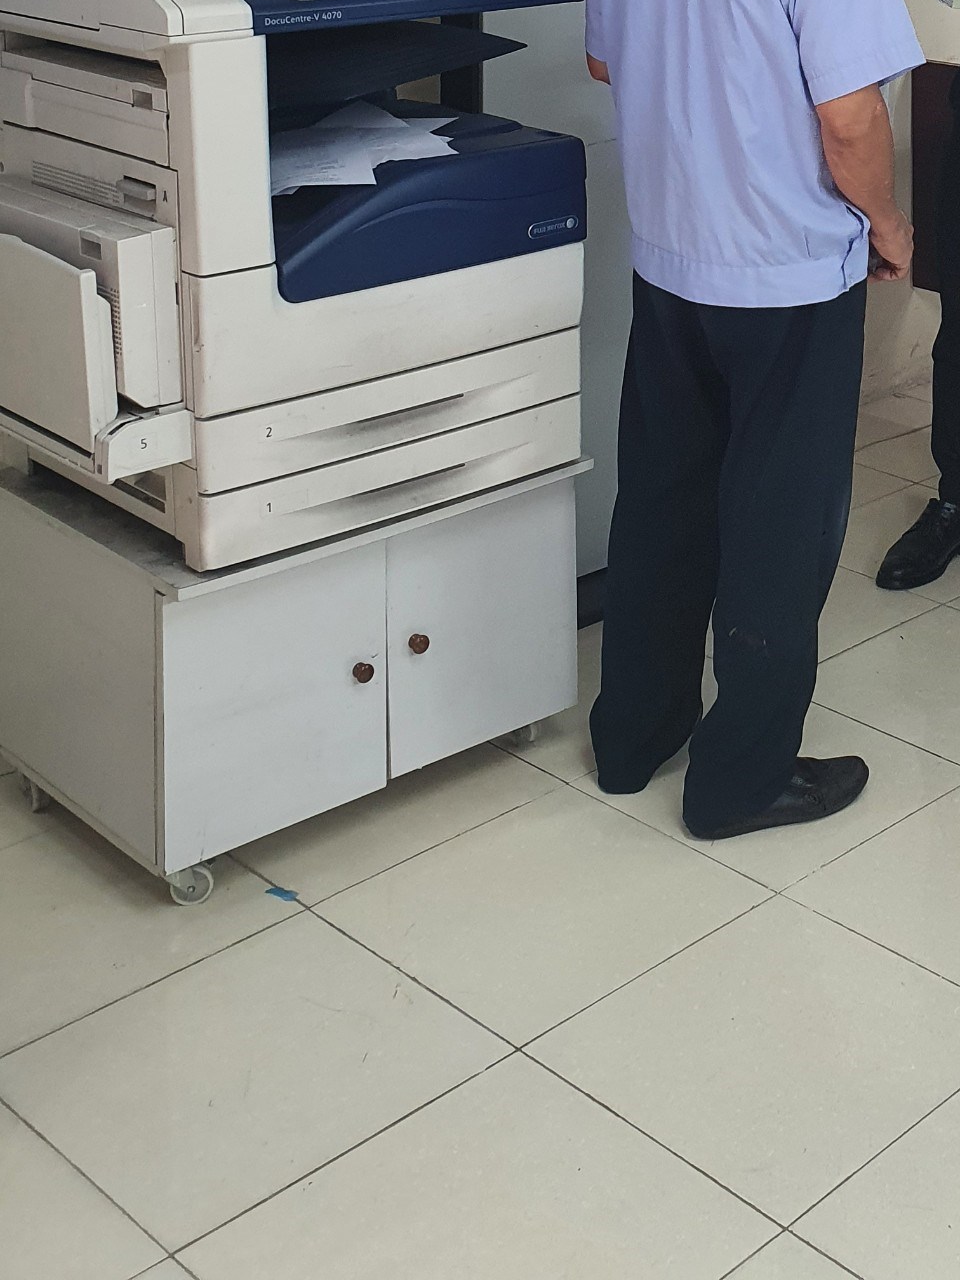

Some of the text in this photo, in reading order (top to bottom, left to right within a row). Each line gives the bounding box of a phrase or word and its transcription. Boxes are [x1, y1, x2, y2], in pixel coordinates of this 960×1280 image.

[264, 10, 342, 26] DocuCentre-V 4070
[265, 426, 273, 438] 2
[140, 437, 148, 450] 5
[266, 502, 272, 513] 1
